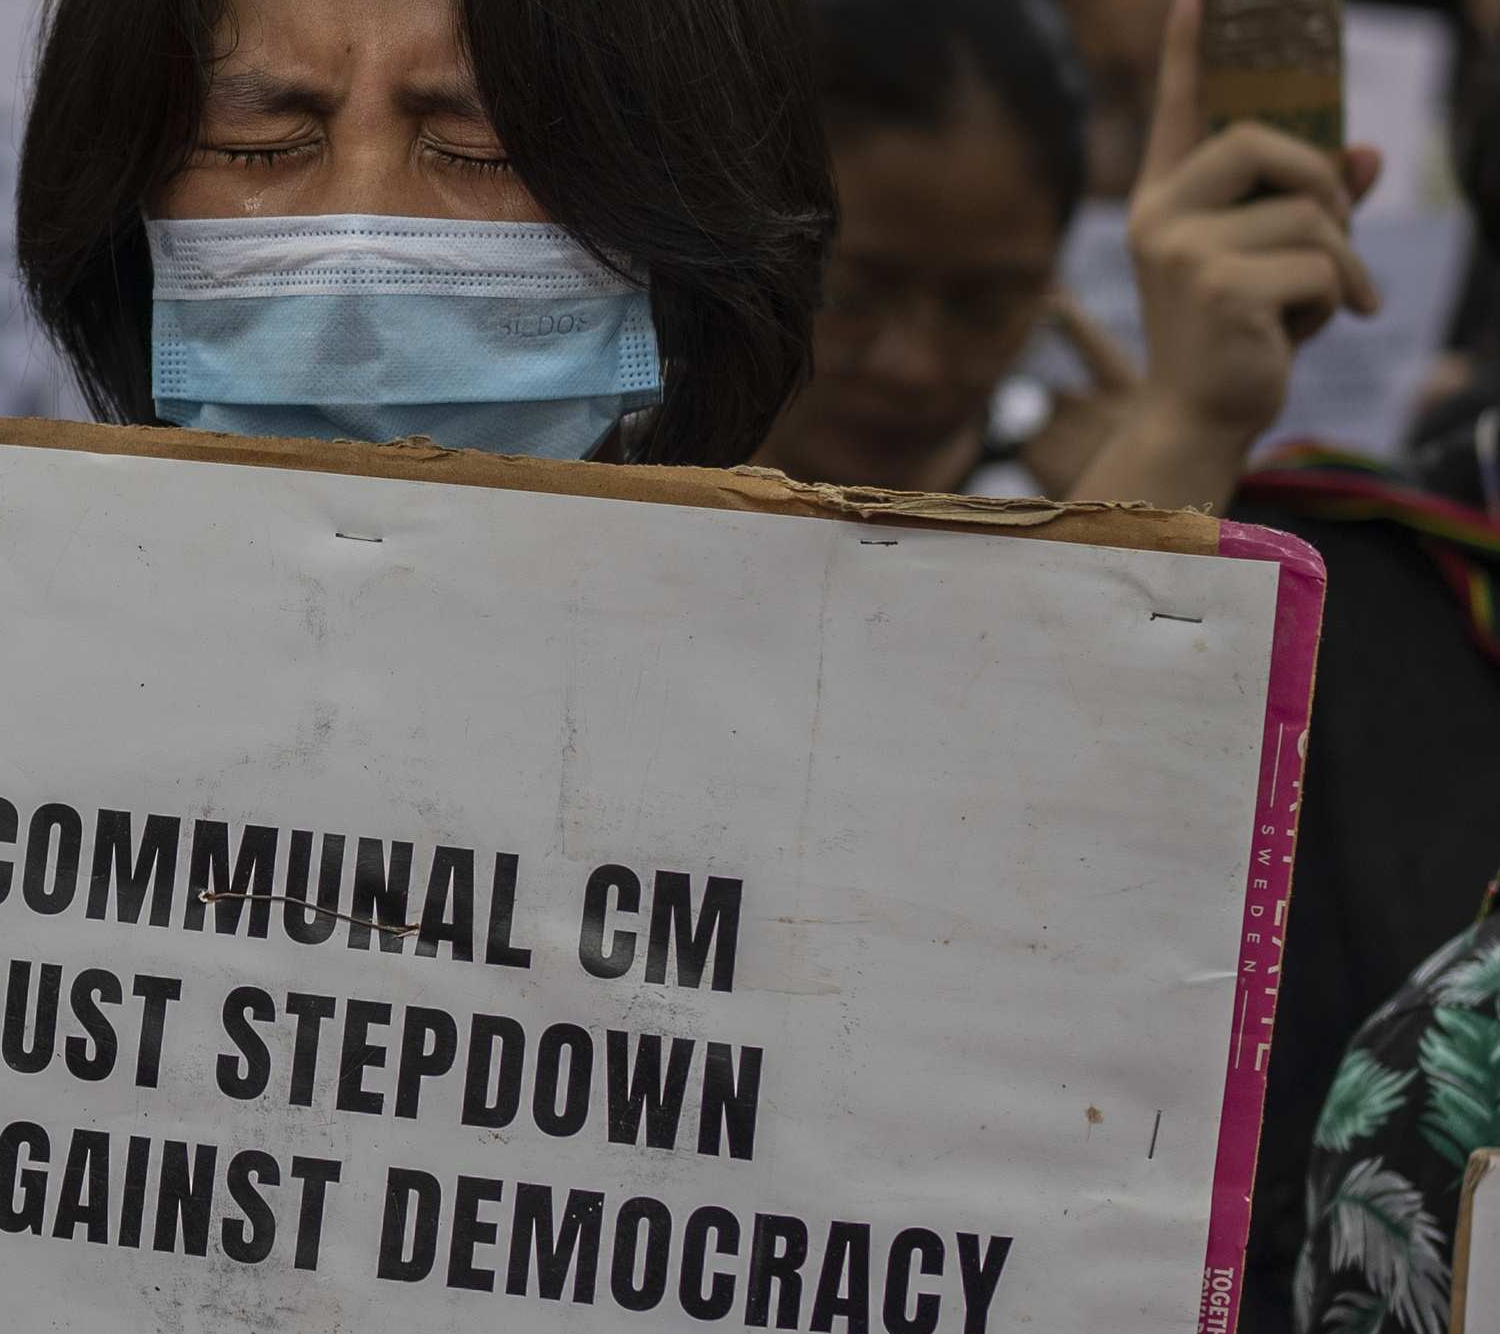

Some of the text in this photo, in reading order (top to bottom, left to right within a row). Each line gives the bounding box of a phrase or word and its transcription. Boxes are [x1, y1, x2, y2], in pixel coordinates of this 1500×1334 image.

[579, 864, 743, 992] CM
[1241, 825, 1274, 974] SWEDEN
[216, 987, 763, 1161] STEPDOWN
